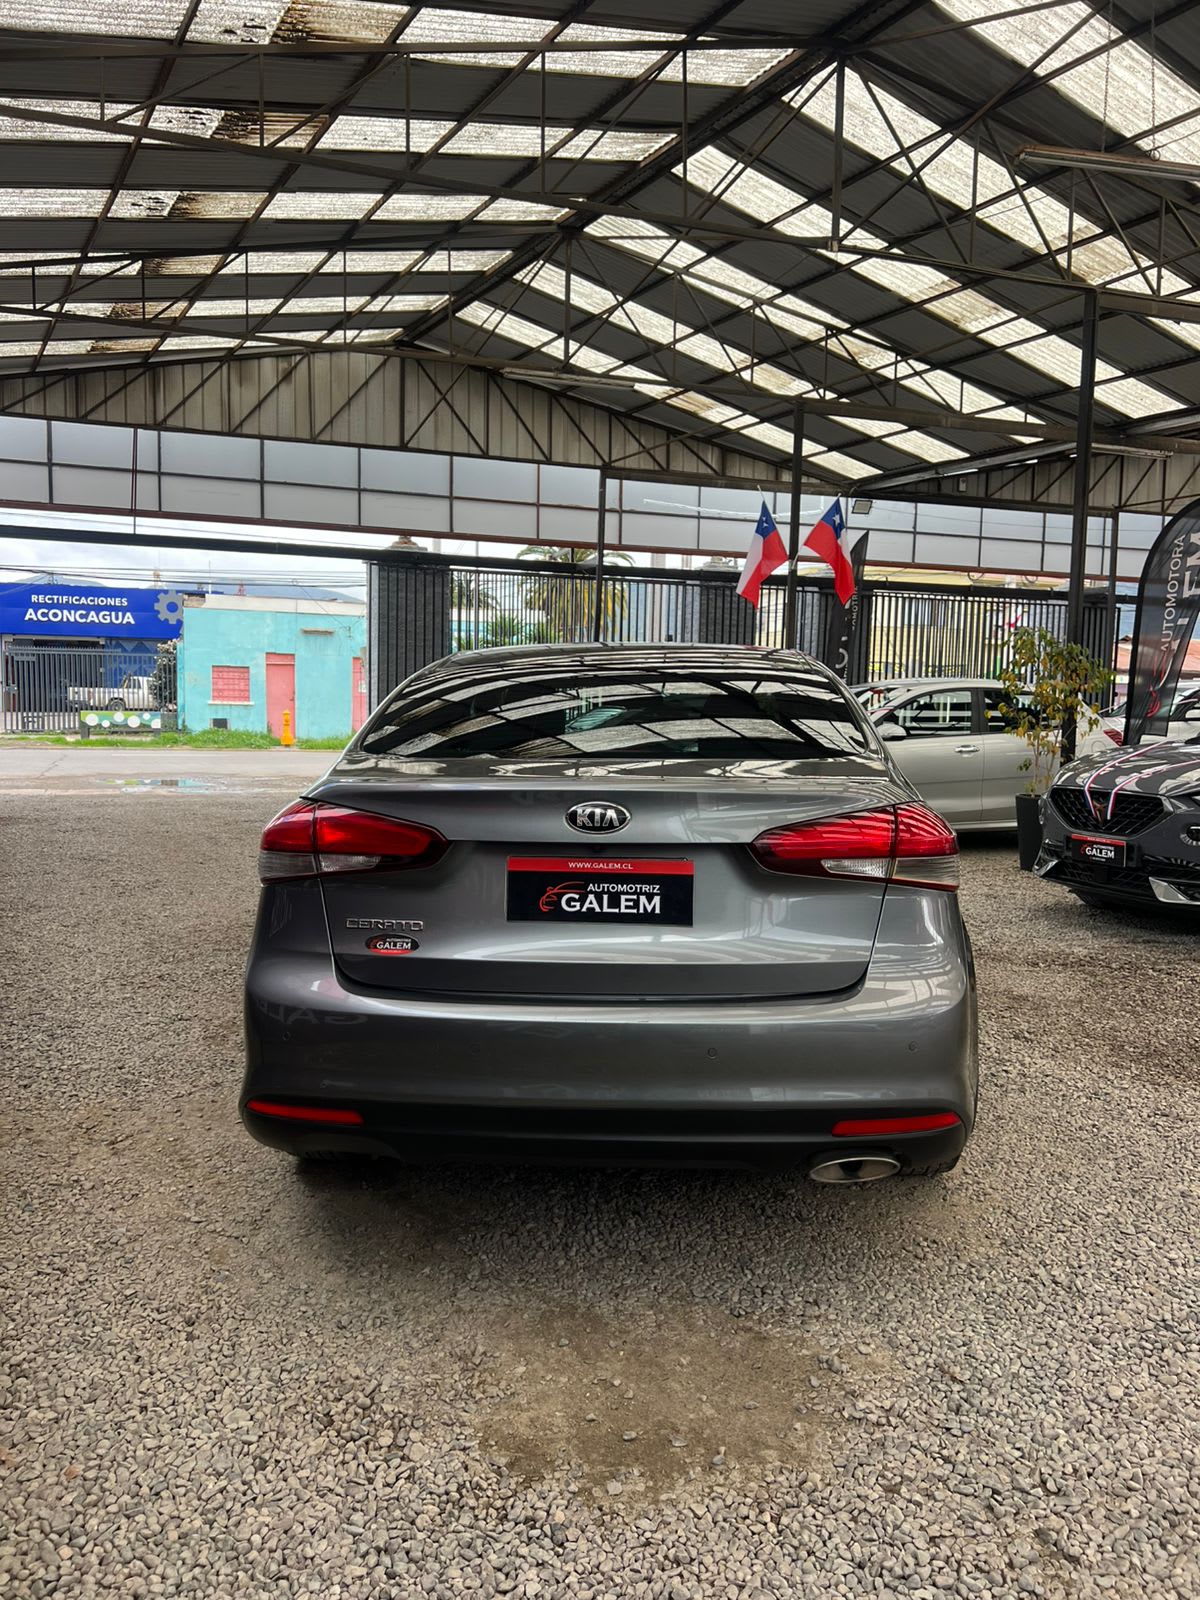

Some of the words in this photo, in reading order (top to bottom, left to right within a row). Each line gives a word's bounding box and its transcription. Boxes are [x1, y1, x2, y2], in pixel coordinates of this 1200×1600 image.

[1160, 534, 1186, 651] AUTOMOTORA
[31, 594, 128, 607] RECTIFICACIONES
[24, 608, 135, 625] ACONCAGUA
[576, 808, 619, 827] KIA
[1085, 847, 1115, 859] GALEM
[568, 861, 634, 870] WWW.GALEM.CL
[587, 883, 661, 893] AUTOMOTRIZ
[561, 894, 661, 914] GALEM
[346, 918, 424, 931] CERATO
[376, 941, 411, 950] GALEM
